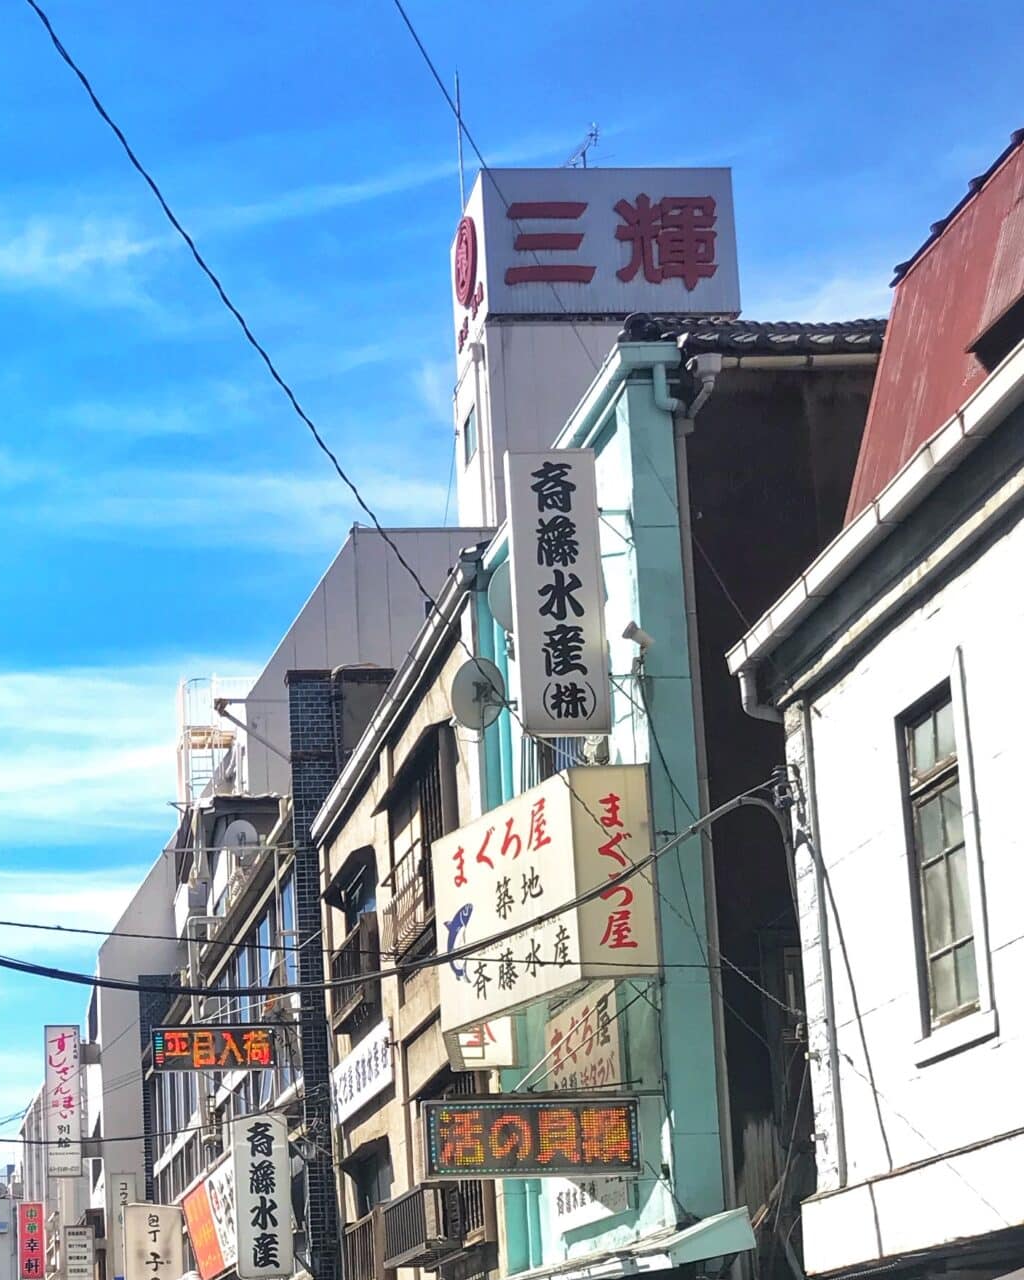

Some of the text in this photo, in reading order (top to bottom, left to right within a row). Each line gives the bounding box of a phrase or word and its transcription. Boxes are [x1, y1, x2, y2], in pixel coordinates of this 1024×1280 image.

[504, 192, 719, 292] 三輝
[452, 797, 552, 889] まぐろ屋
[597, 793, 639, 949] まぐろ屋
[495, 866, 544, 920] 築地
[48, 1033, 75, 1120] すしざんまい
